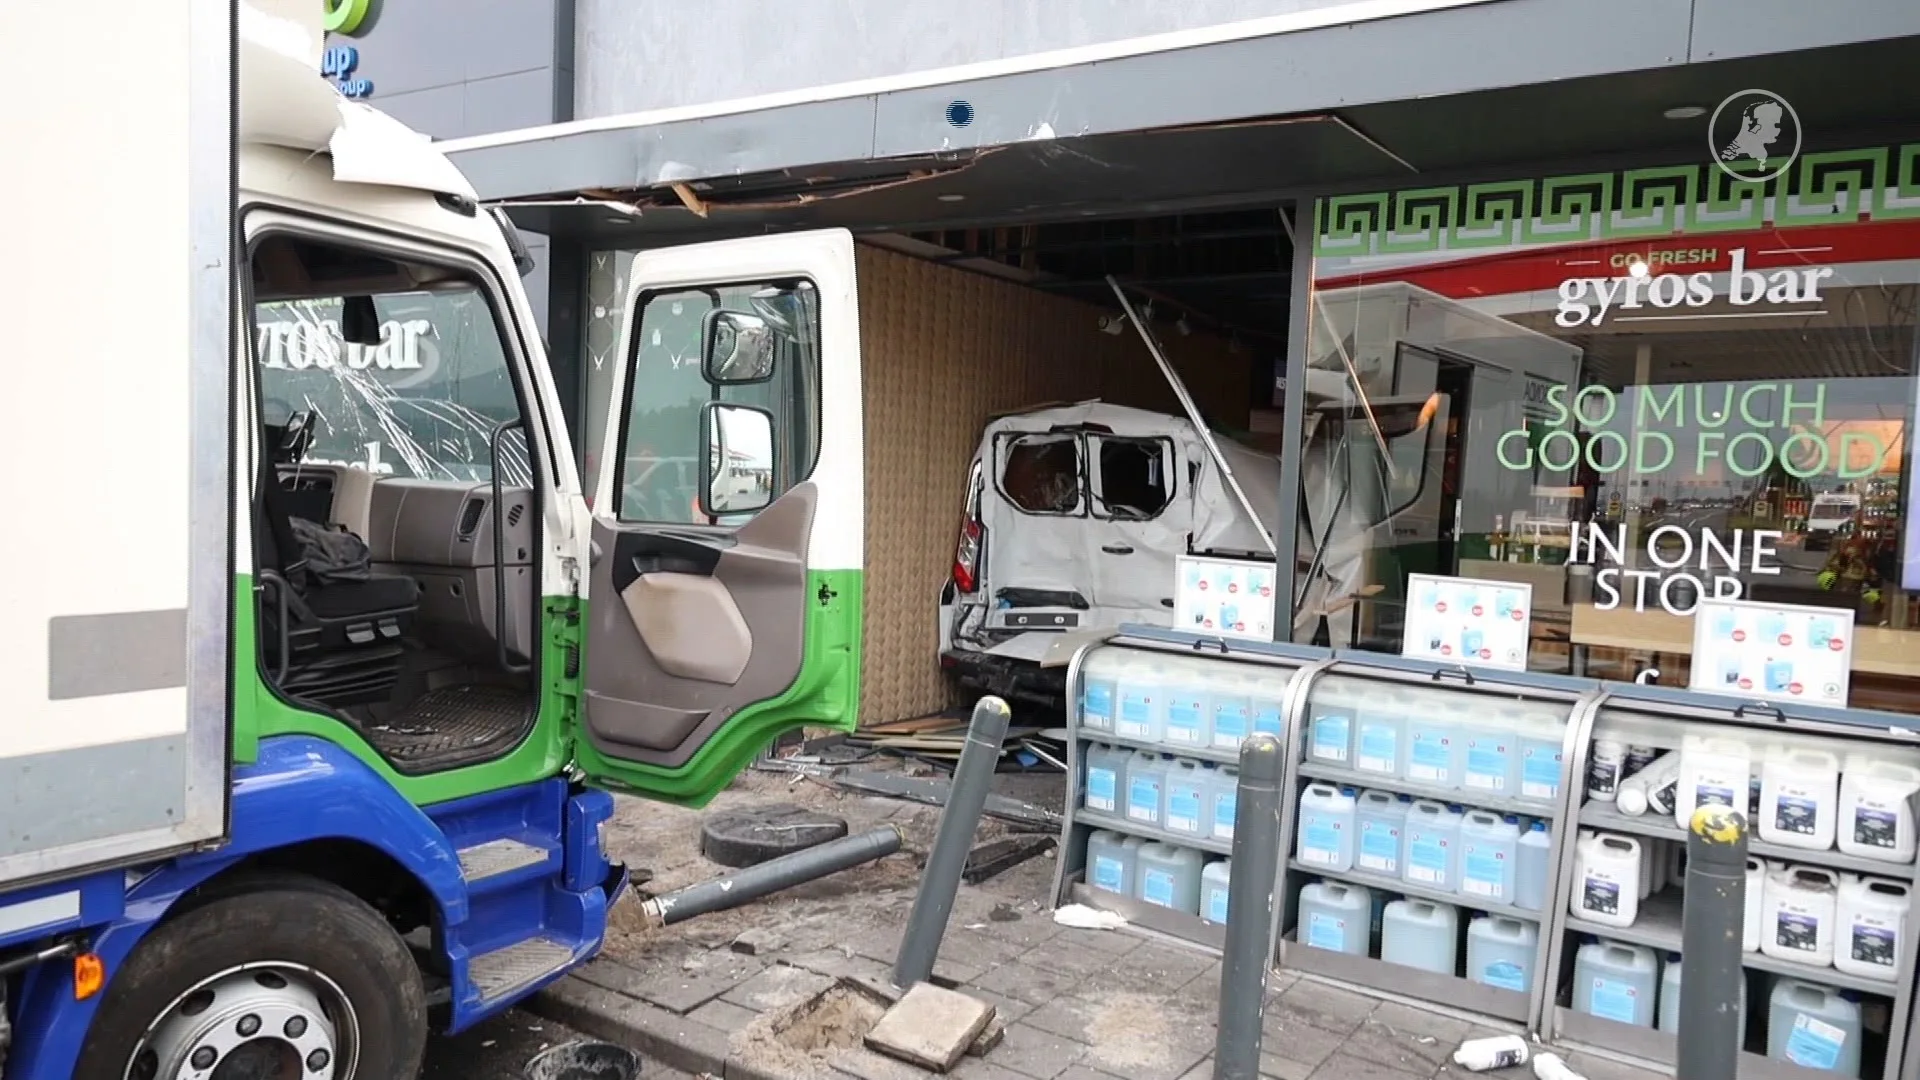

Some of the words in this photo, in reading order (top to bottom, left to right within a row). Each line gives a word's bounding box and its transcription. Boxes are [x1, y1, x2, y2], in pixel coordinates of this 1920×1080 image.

[1610, 252, 1642, 268] GO
[1648, 248, 1717, 266] FRESH
[1555, 270, 1713, 327] gyros
[1728, 248, 1834, 306] bar
[257, 319, 346, 371] ros
[1544, 384, 1616, 428] SO
[1636, 383, 1827, 428] MUCH
[1496, 430, 1675, 474] GOOD
[1695, 432, 1885, 478] FOOD
[1568, 521, 1628, 566] IN
[1647, 525, 1783, 575] ONE
